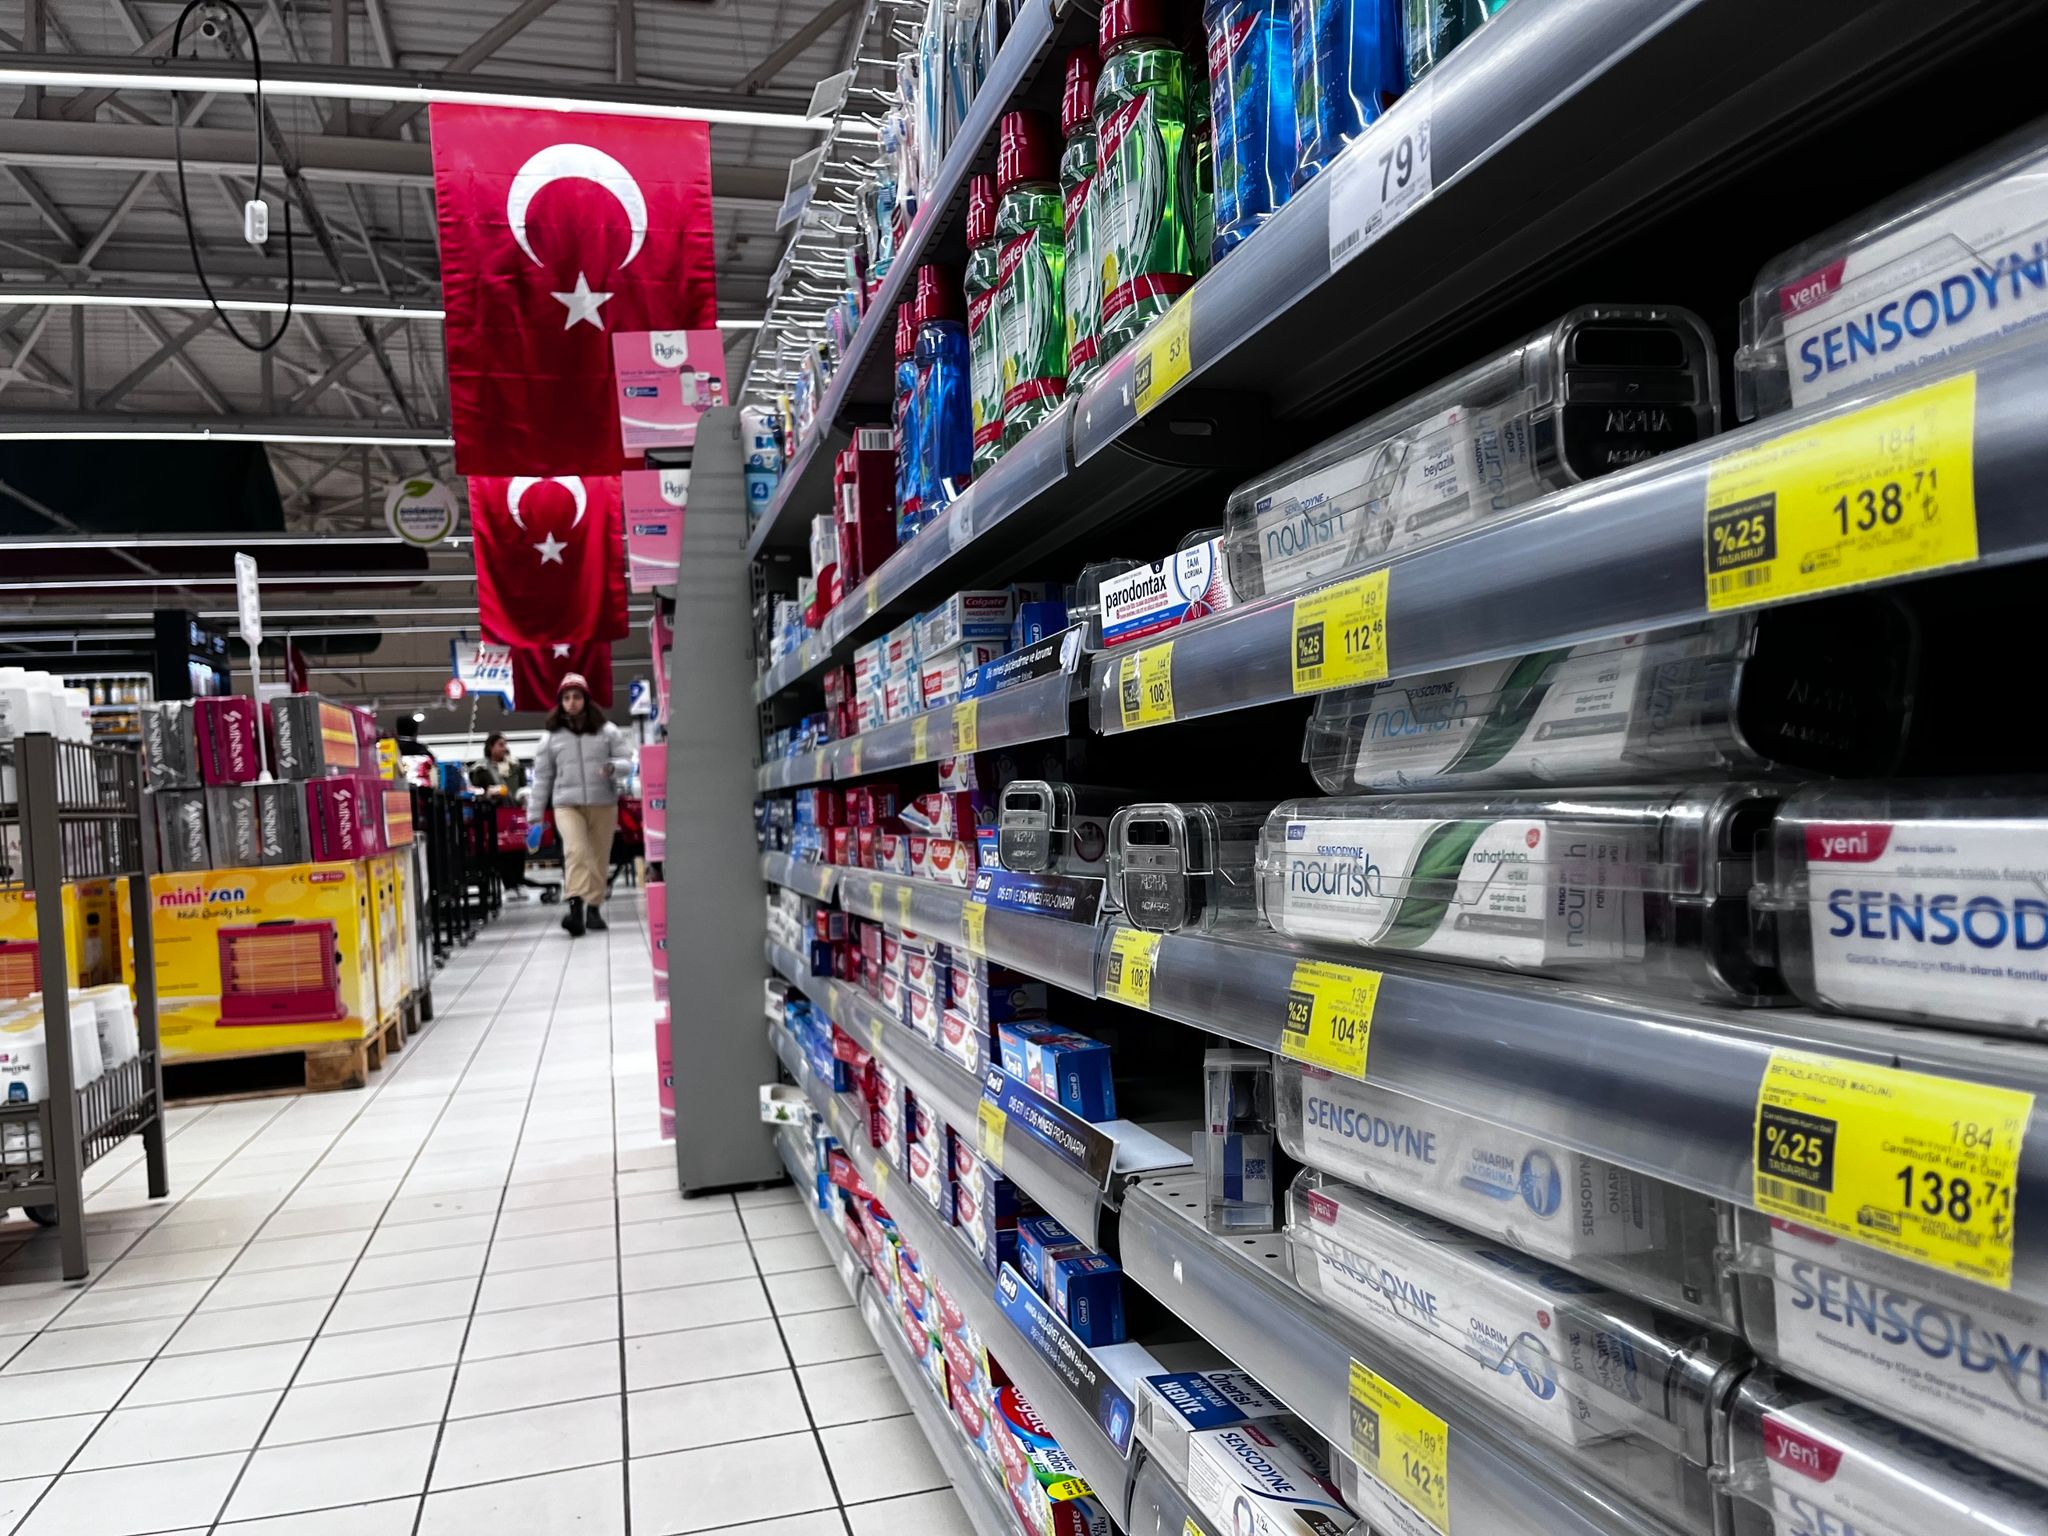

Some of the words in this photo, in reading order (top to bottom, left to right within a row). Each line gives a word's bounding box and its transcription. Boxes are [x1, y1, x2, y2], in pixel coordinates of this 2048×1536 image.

[1378, 135, 1413, 203] 79
[1789, 273, 1828, 311] yeni
[1713, 514, 1766, 555] %25
[1186, 557, 1200, 569] TAM
[1105, 573, 1168, 618] parodontax
[1299, 635, 1320, 657] %25
[1317, 845, 1364, 859] SENSODYNE
[1820, 831, 1869, 858] yeni
[1291, 853, 1380, 898] nourish
[1827, 888, 2048, 951] SENSOD
[1288, 1001, 1308, 1024] %25
[1308, 1096, 1437, 1166] SENSODYNE
[1952, 1120, 1995, 1151] 184
[1471, 1148, 1514, 1173] ONARIM
[1766, 1126, 1823, 1167] %25
[1768, 1159, 1820, 1182] TASARRUF
[1312, 1200, 1331, 1217] yeni
[999, 1271, 1018, 1298] Oral-B
[1079, 1299, 1088, 1323] Oral-B
[1470, 1317, 1509, 1346] ONARIM
[1158, 1381, 1207, 1415] HEDİYE
[1352, 1409, 1376, 1442] %25
[1418, 1429, 1437, 1454] 189
[1776, 1434, 1821, 1470] yeni
[1043, 1449, 1066, 1473] Action
[1219, 1432, 1297, 1494] SENSODYNE
